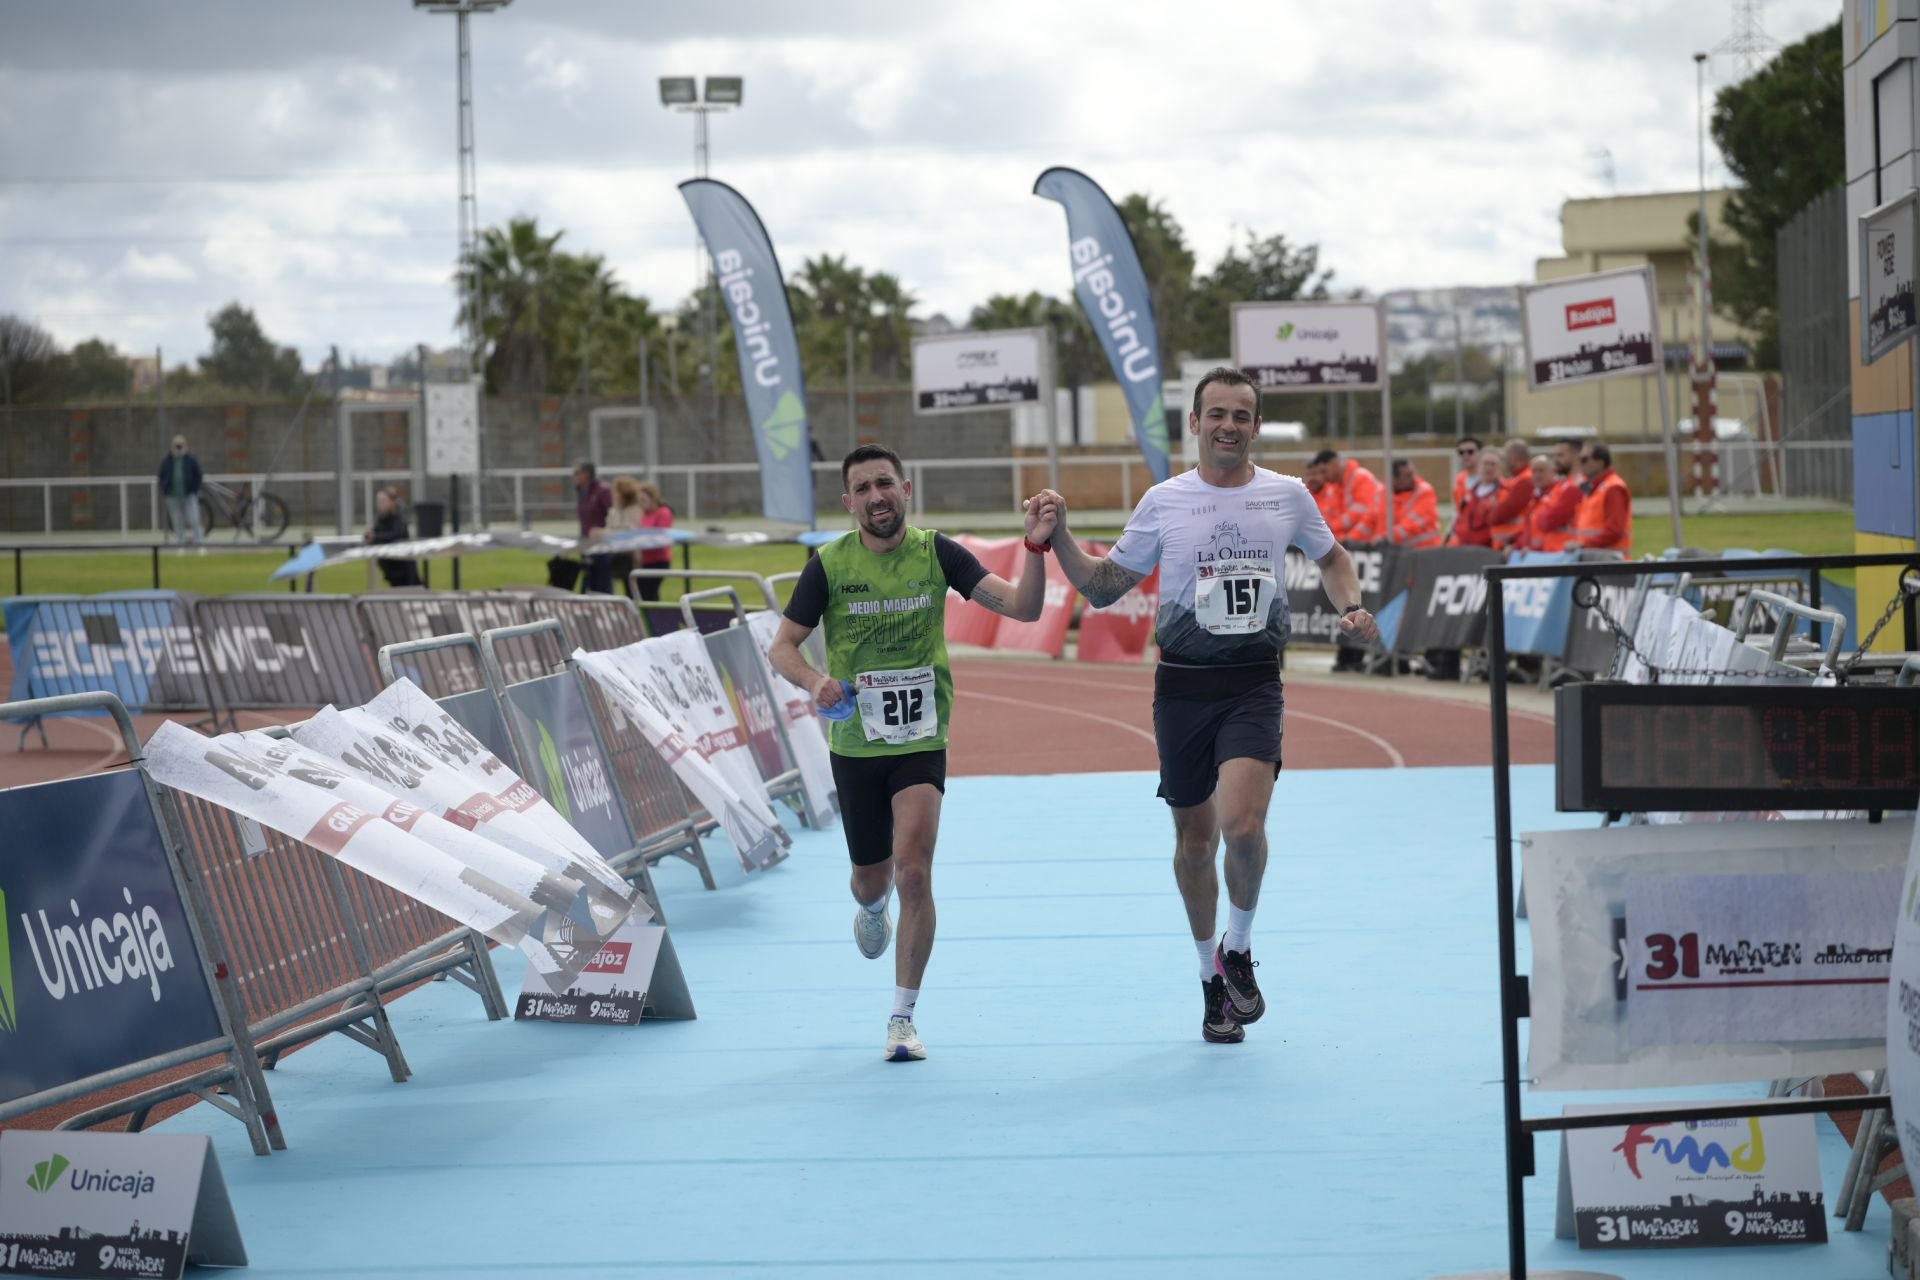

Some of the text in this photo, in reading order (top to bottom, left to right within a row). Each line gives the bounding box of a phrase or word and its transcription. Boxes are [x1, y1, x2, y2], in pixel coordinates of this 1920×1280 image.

[1197, 546, 1268, 562] La Quinta
[1199, 565, 1214, 578] 31
[841, 583, 869, 594] HOKA
[1223, 578, 1261, 616] 151
[848, 593, 932, 615] MEDIO MARATÓN
[846, 606, 934, 645] SEVILLA
[882, 688, 923, 726] 212
[560, 745, 612, 820] Unicaja
[20, 886, 175, 1002] Unicaja
[1645, 932, 1700, 980] 31
[525, 999, 544, 1017] 31
[589, 1000, 601, 1018] 9
[70, 1168, 156, 1200] Unicaja
[1595, 1215, 1631, 1242] 31
[1724, 1209, 1745, 1236] 9
[1745, 1211, 1773, 1220] MEDIO
[98, 1244, 117, 1270] 9
[117, 1247, 141, 1255] MEDIO
